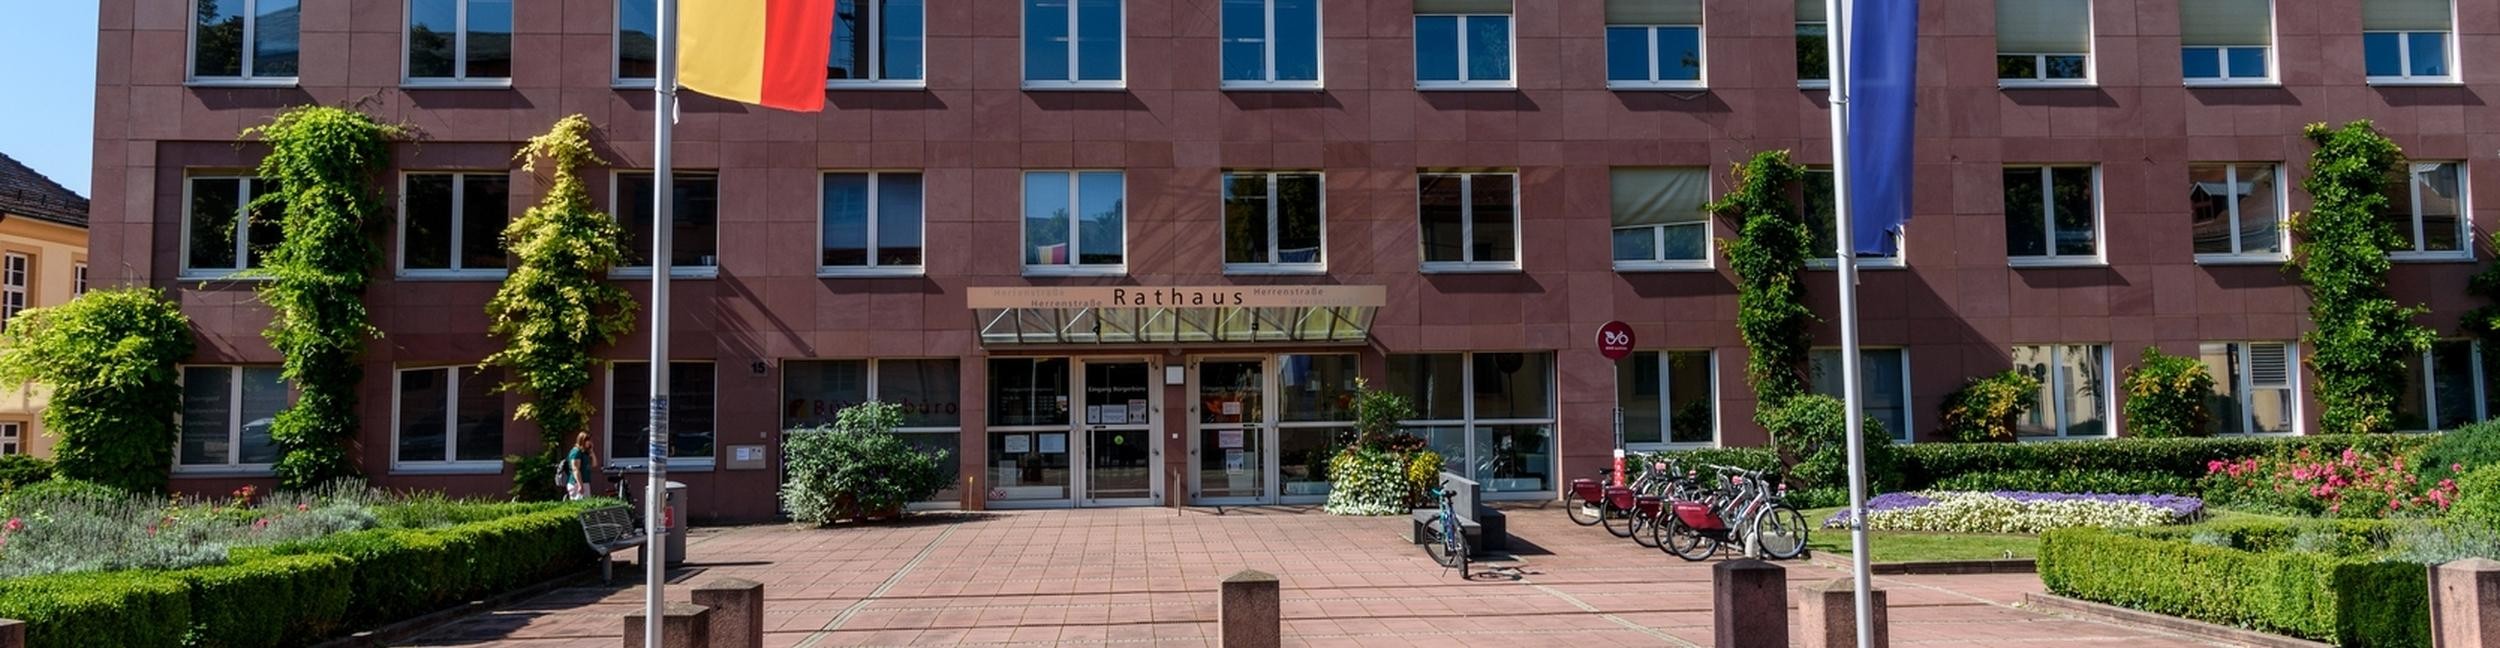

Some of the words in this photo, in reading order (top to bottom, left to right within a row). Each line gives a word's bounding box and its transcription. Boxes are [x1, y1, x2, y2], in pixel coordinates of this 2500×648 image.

[1113, 288, 1243, 306] Rathaus
[1253, 287, 1323, 296] Herrenstraße
[1031, 299, 1102, 307] Herrenstraße
[751, 361, 766, 374] 15
